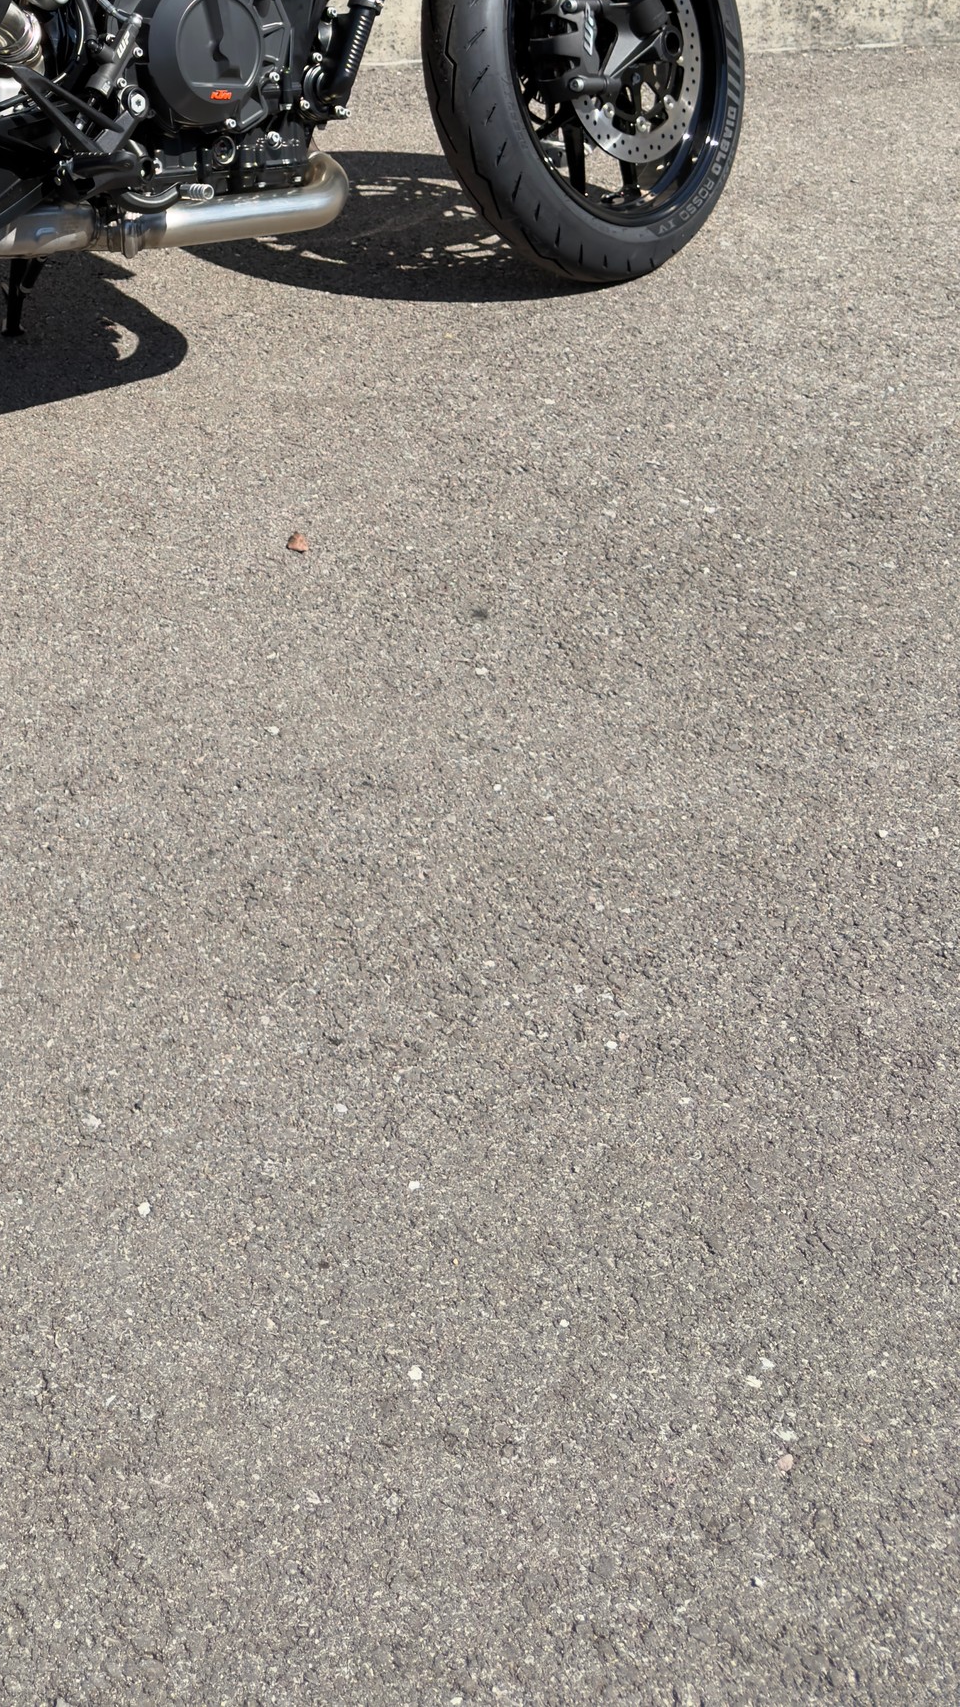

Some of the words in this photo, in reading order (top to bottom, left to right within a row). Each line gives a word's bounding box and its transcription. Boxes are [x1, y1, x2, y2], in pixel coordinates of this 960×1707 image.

[116, 30, 130, 59] WP
[583, 1, 594, 56] WP
[210, 89, 233, 100] KTM
[711, 105, 738, 175] DIABLO
[679, 178, 715, 221] ROSSO
[657, 219, 677, 234] IV
